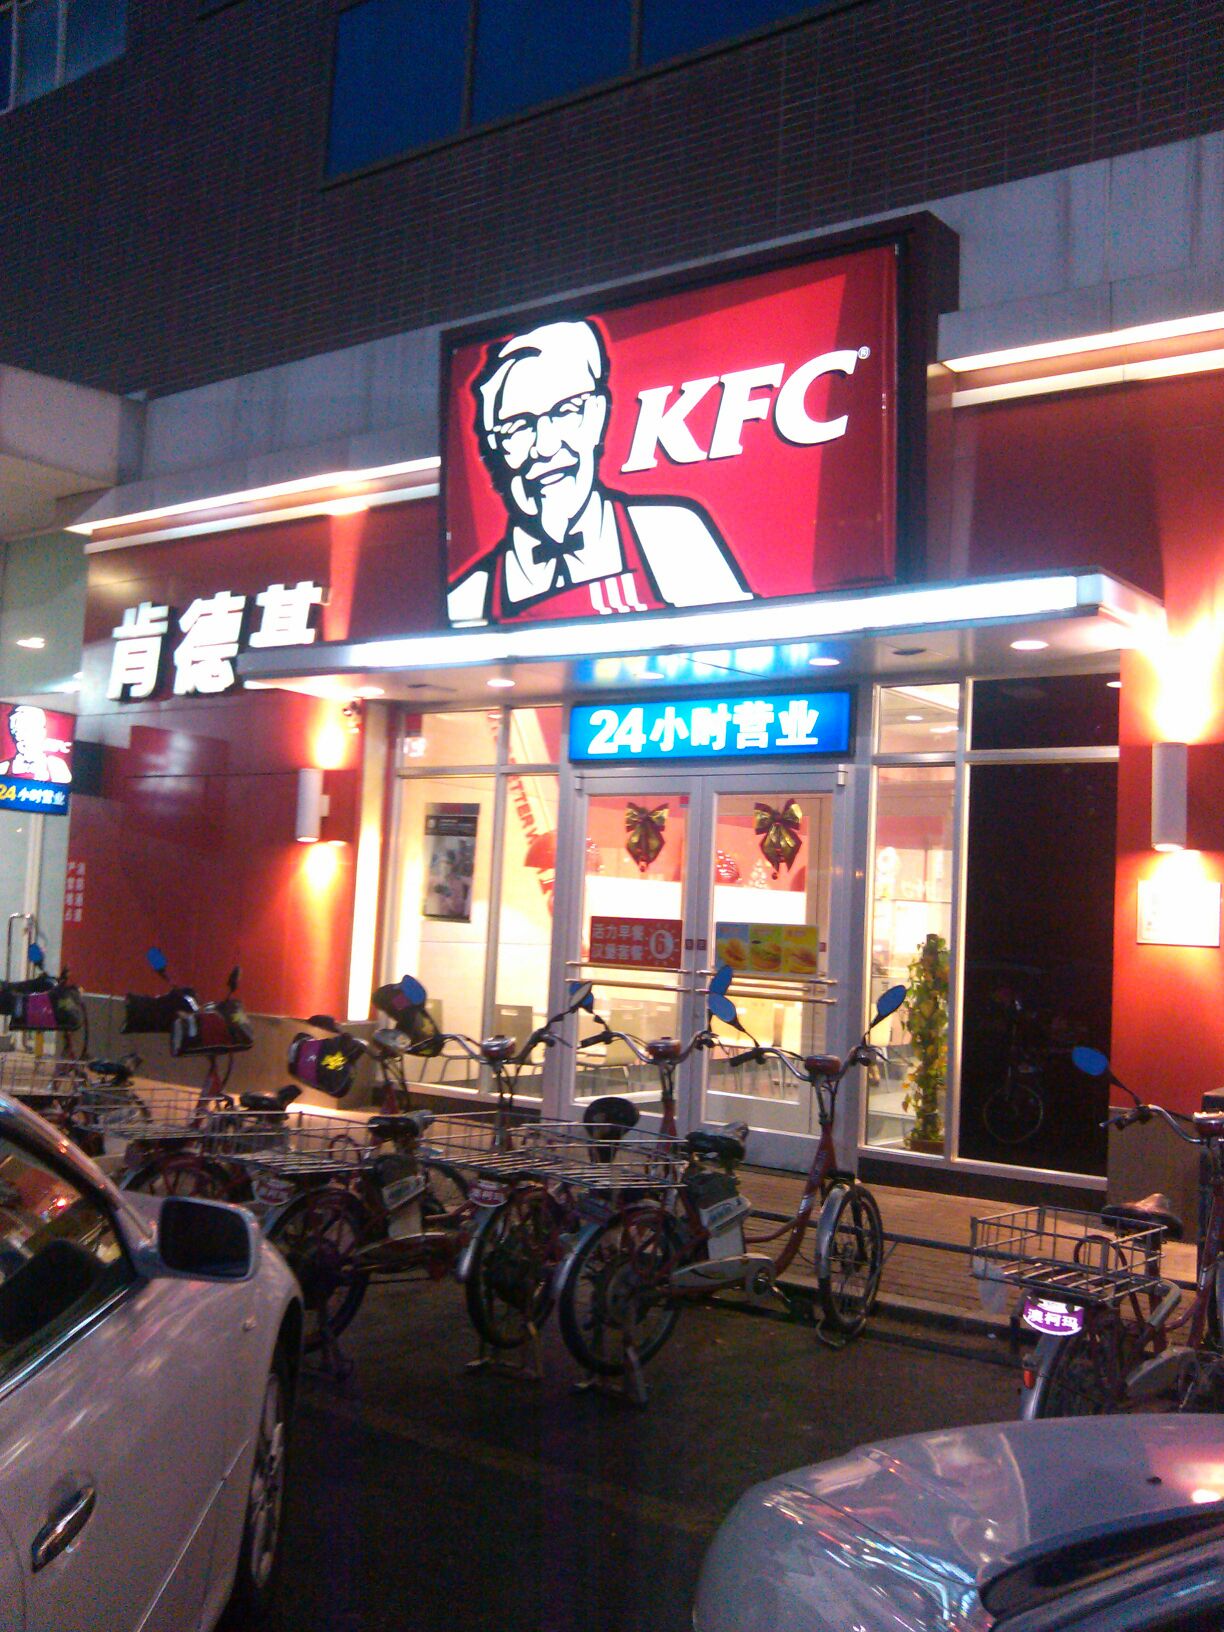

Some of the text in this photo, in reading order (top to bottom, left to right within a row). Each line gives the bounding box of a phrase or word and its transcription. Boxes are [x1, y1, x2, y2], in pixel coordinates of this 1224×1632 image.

[620, 348, 859, 475] KFC
[106, 580, 323, 699] 肯德基
[587, 699, 820, 755] 24小时营业
